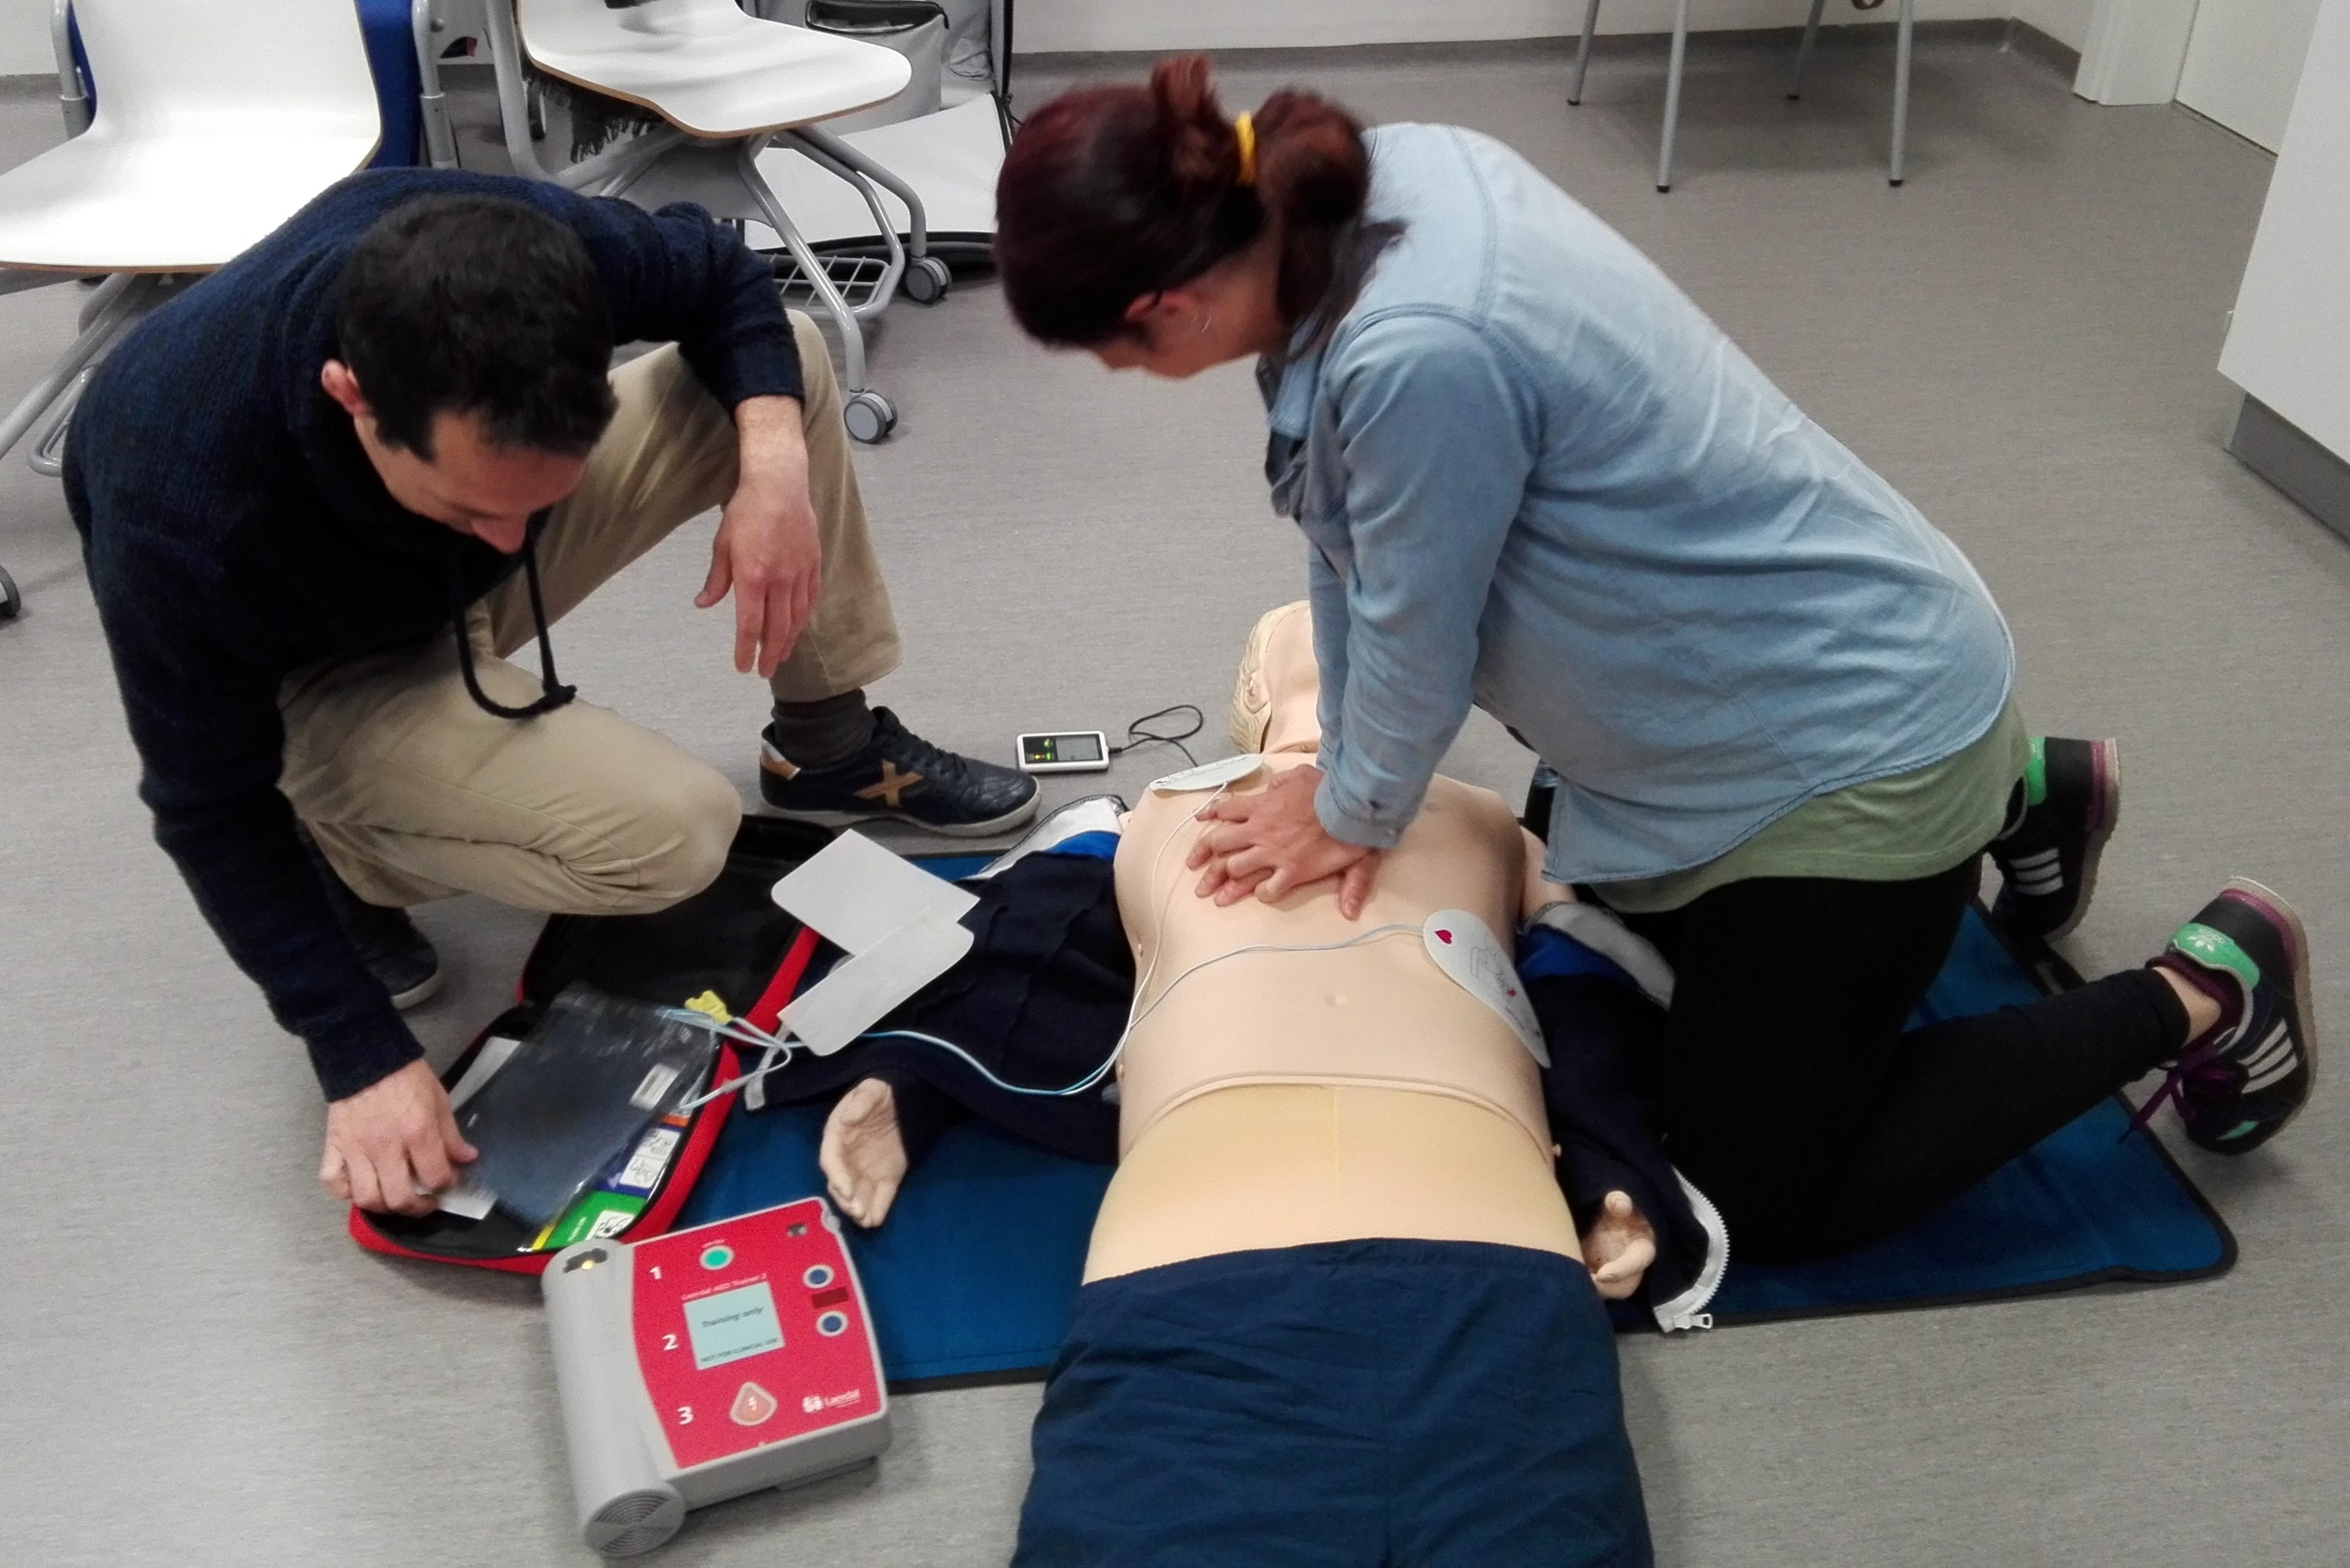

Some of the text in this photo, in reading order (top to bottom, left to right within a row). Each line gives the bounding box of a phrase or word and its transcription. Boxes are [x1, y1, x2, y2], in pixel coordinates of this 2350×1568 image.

[650, 1265, 662, 1280] 1
[701, 1308, 763, 1328] Training only
[662, 1333, 679, 1351] 2
[677, 1406, 694, 1425] 3
